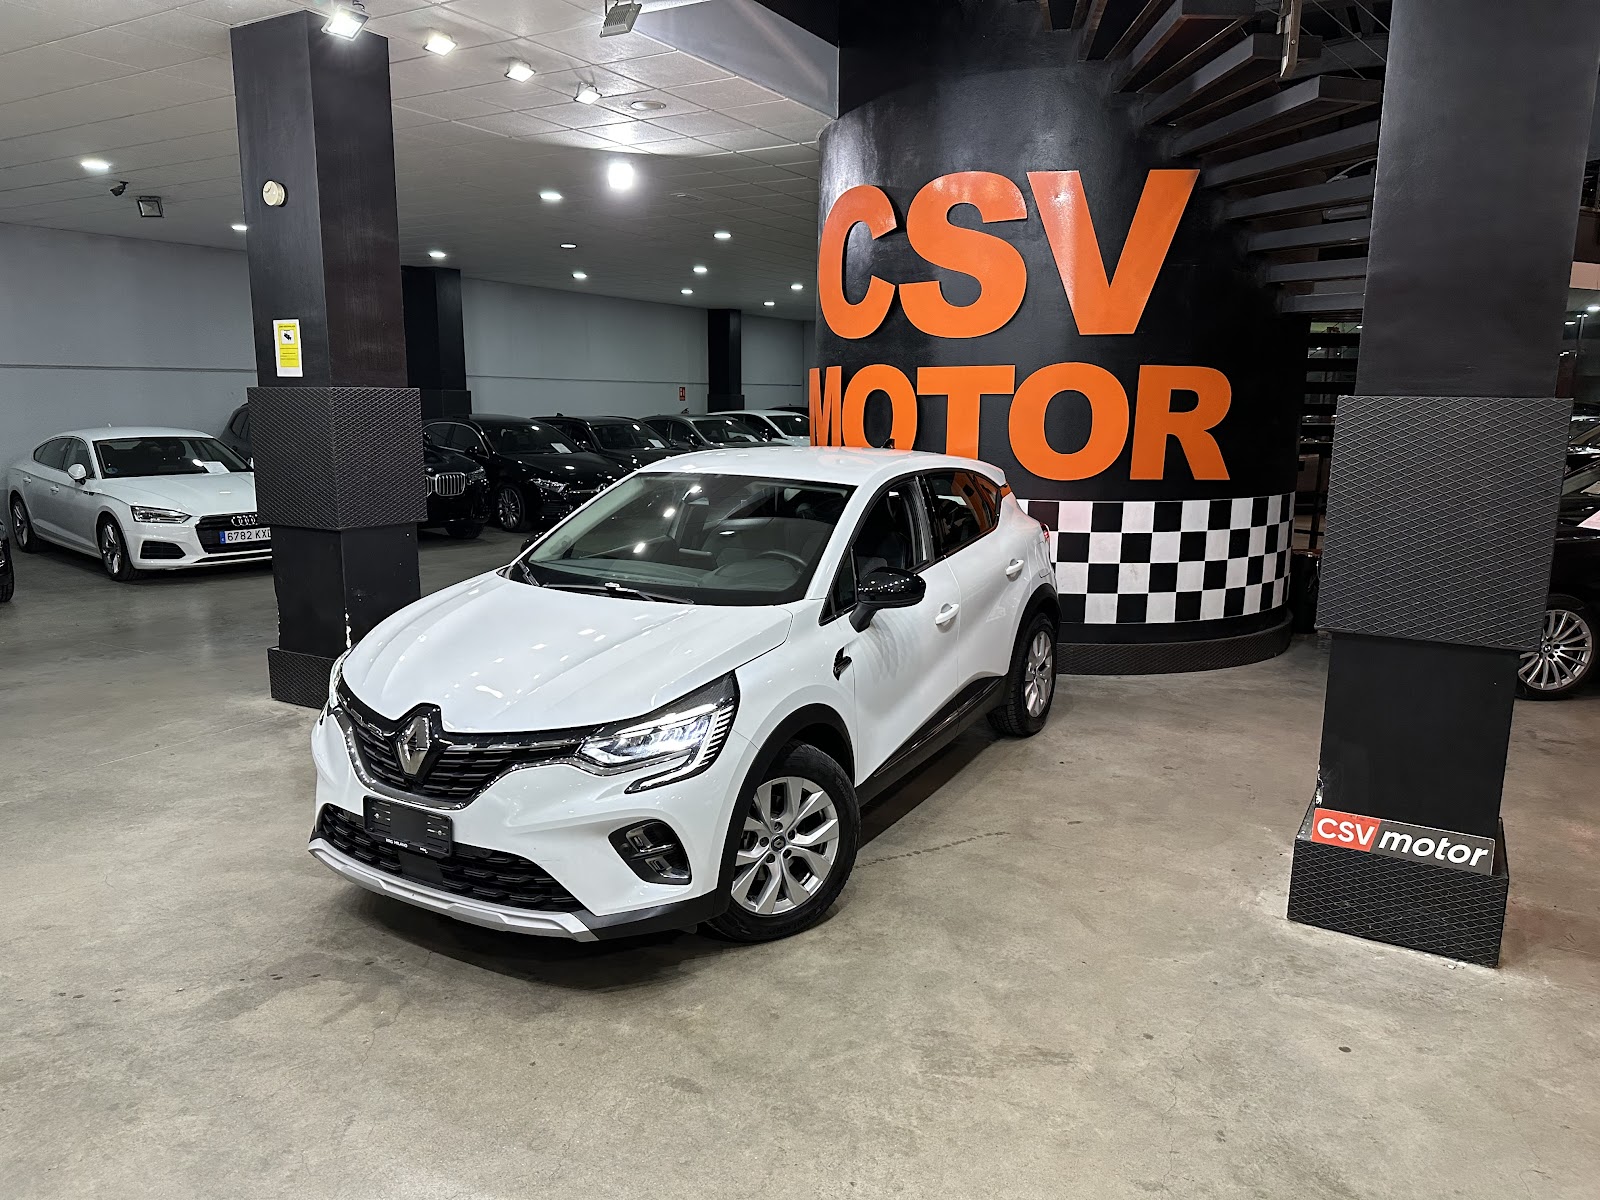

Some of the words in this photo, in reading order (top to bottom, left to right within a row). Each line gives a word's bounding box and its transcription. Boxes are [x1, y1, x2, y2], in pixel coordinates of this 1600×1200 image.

[818, 169, 1200, 339] CSV
[808, 361, 1232, 481] MOTOR
[227, 530, 252, 541] 6782
[1317, 817, 1376, 846] CSV
[1378, 829, 1489, 867] motor
